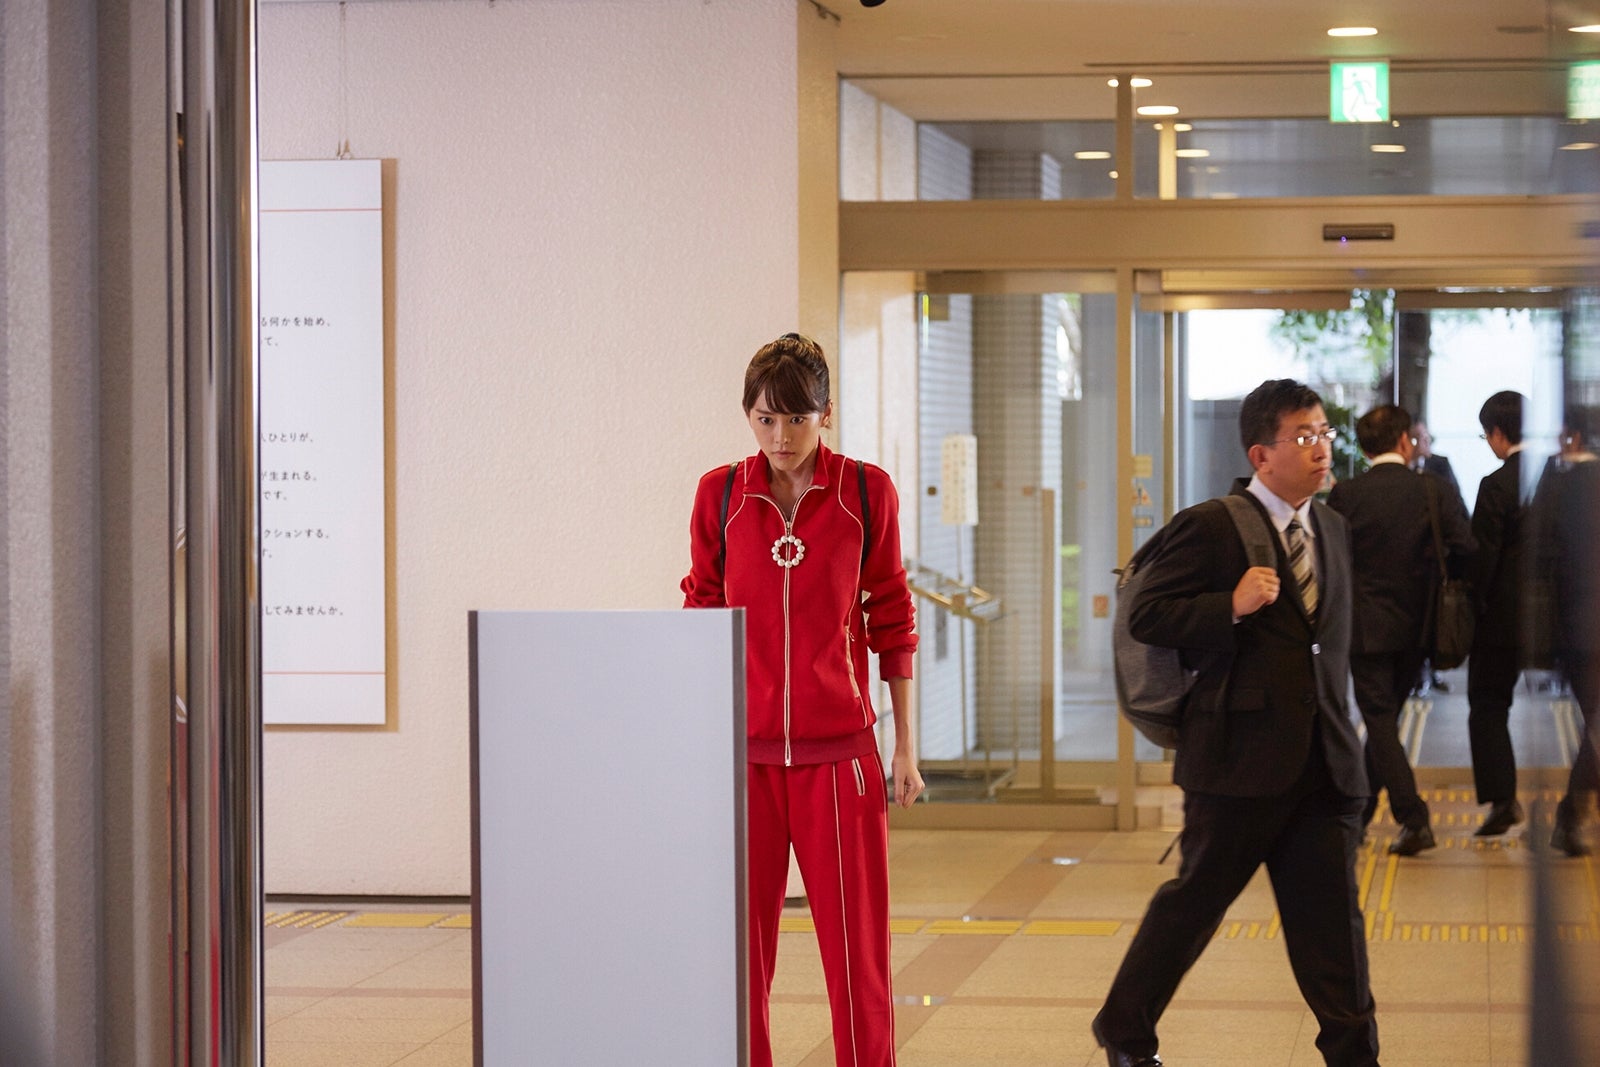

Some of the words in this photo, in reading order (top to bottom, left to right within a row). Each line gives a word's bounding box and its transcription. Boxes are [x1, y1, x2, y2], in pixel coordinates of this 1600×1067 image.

[263, 491, 287, 501] です。
[265, 605, 343, 616] してみませんか。
